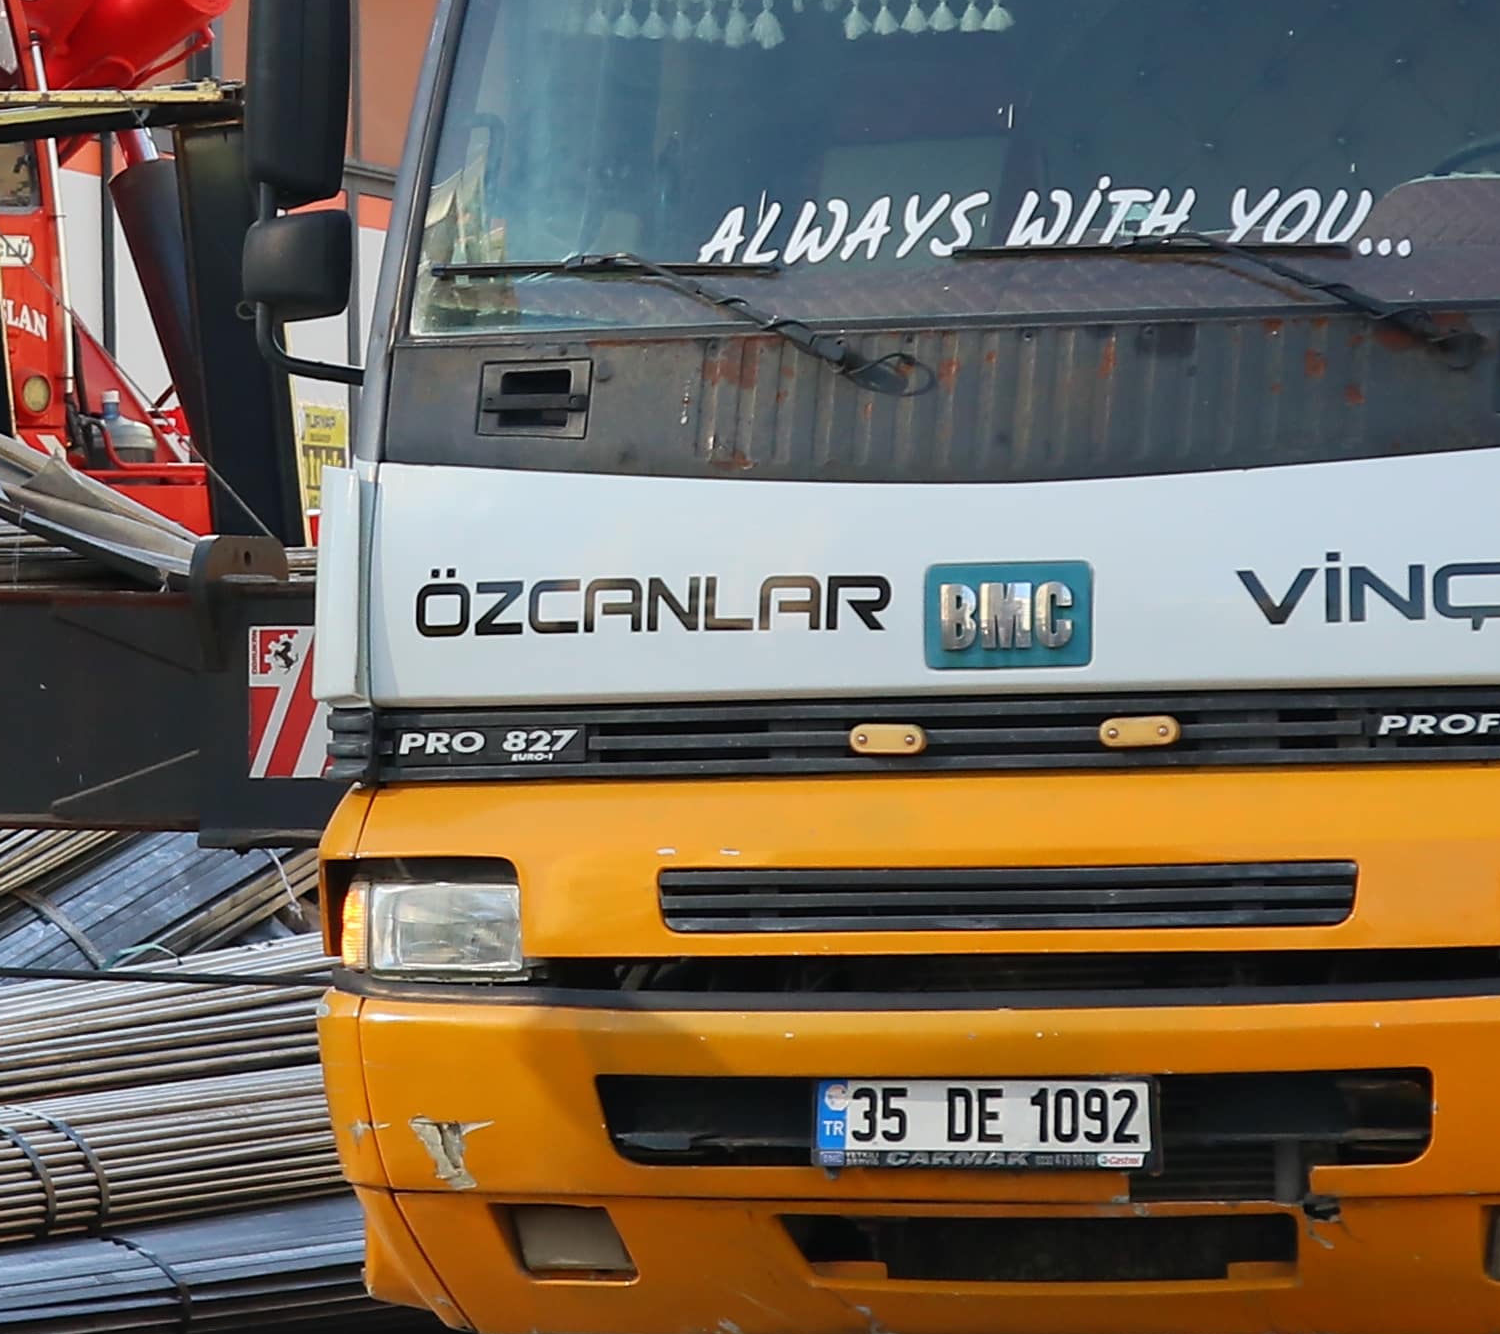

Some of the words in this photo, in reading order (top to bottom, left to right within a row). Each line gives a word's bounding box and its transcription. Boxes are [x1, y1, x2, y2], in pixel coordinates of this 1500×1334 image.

[698, 189, 990, 265] ALWAYS
[414, 567, 892, 639] ÖZCANLAR
[940, 580, 1073, 651] BMC
[399, 730, 486, 756] PRO
[502, 729, 579, 753] 827
[511, 752, 554, 762] EURO-1
[823, 1120, 845, 1137] TR
[851, 1087, 908, 1142] 35
[947, 1087, 1003, 1143] DE
[1030, 1087, 1140, 1144] 1092
